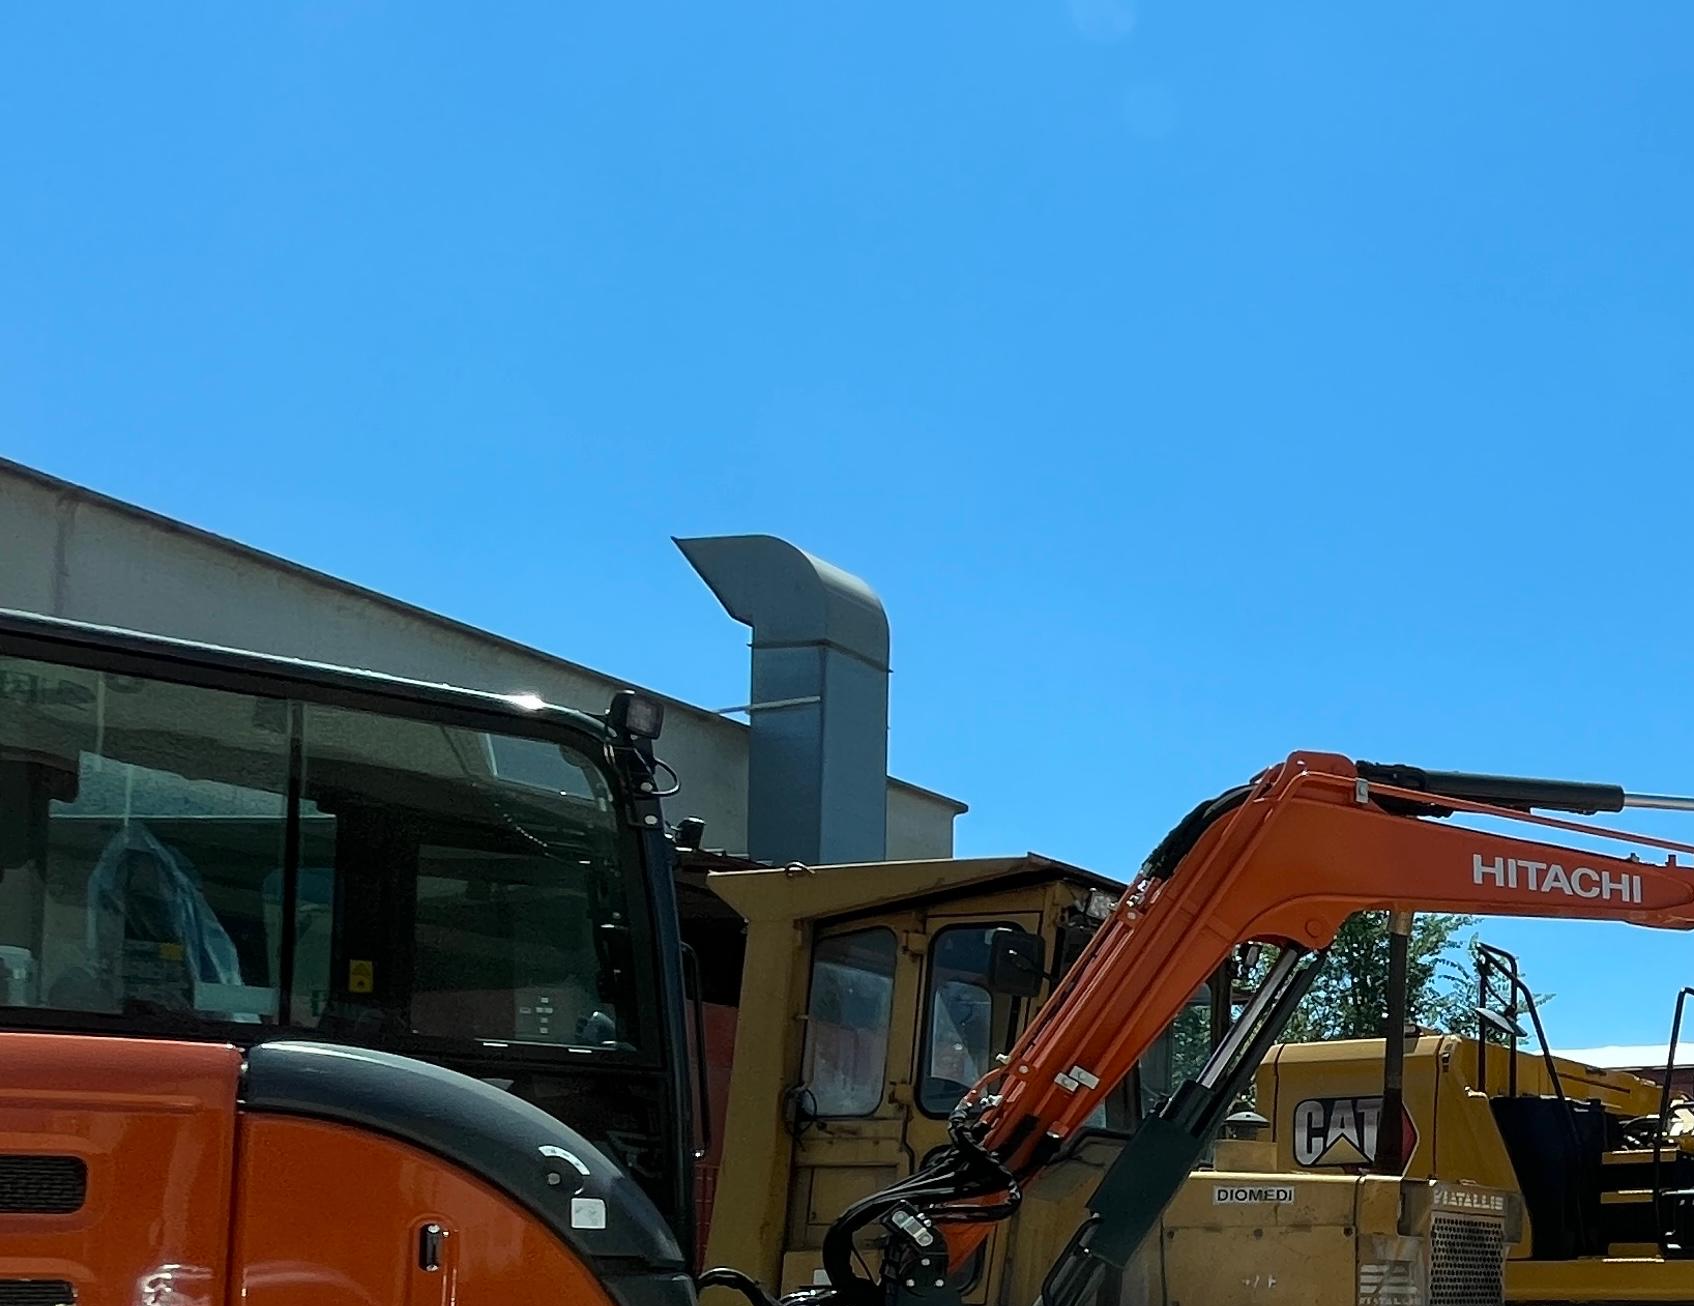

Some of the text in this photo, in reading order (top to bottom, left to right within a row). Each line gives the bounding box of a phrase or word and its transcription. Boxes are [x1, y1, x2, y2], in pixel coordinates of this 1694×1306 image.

[1472, 853, 1642, 903] HITACHI
[1295, 1099, 1383, 1166] CAT
[1215, 1188, 1293, 1202] DIOMEDI
